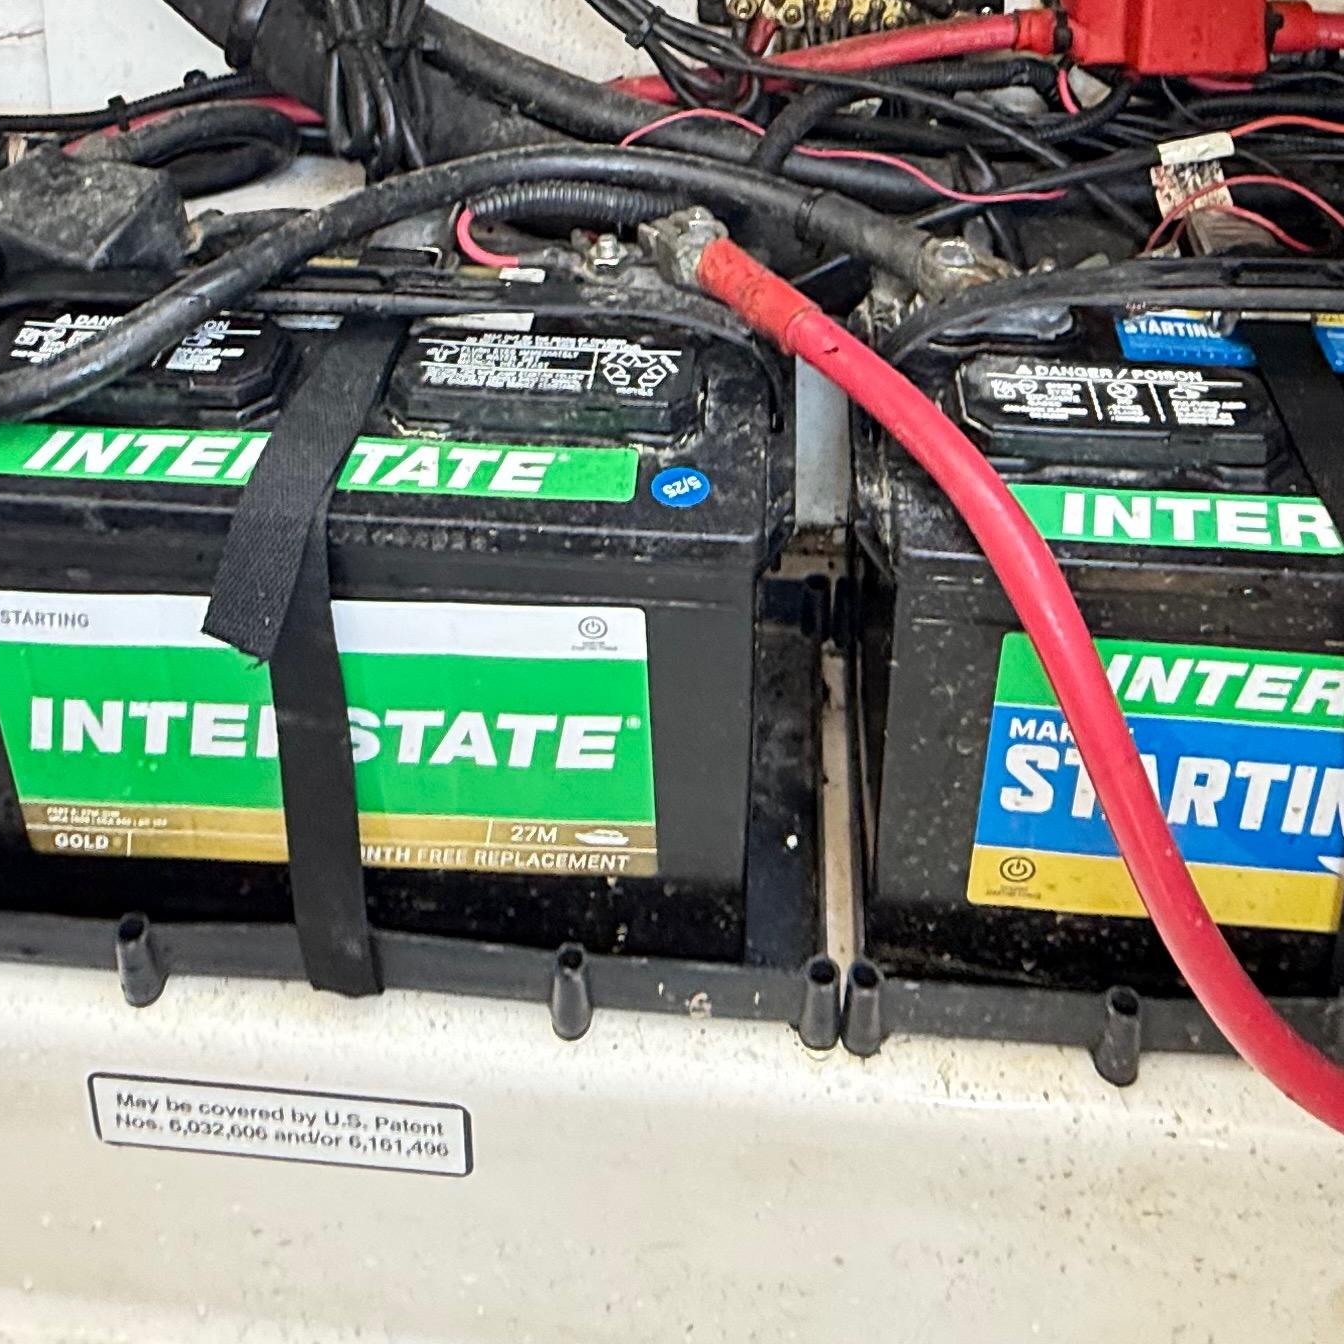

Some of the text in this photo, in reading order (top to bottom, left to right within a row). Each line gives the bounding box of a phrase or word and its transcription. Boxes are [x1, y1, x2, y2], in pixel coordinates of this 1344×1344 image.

[1035, 366, 1112, 379] DANGER
[1131, 369, 1203, 382] POISON
[23, 430, 556, 492] INTETATE
[0, 609, 89, 628] STARTING
[55, 832, 109, 850] GOLD
[511, 825, 557, 843] 27M
[473, 849, 630, 870] REPLACEMENT
[116, 1093, 444, 1136] May be covered by U.S. Patent
[115, 1114, 164, 1130] Nos.
[274, 1127, 343, 1149] and/or
